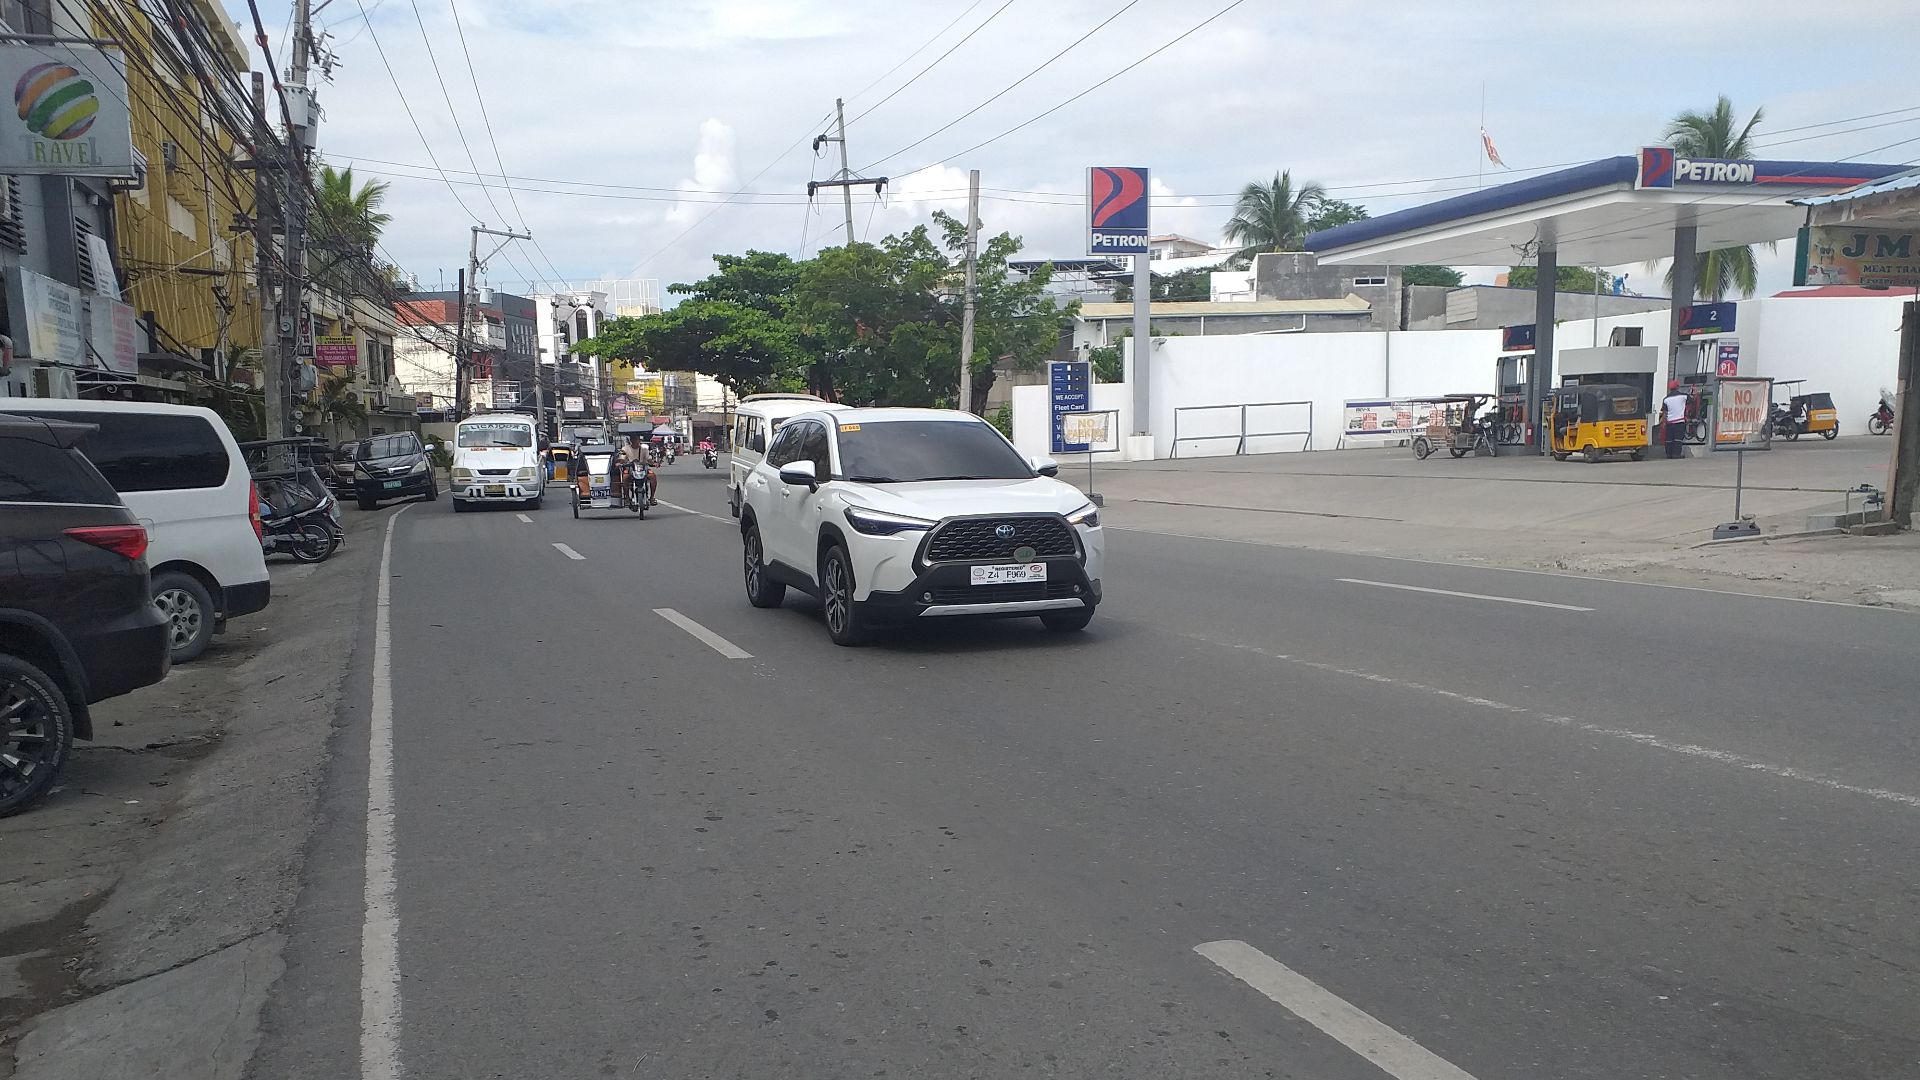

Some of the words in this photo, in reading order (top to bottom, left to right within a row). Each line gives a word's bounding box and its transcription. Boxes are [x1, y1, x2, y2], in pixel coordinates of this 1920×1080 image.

[19, 136, 103, 166] TRAVEL
[1675, 159, 1754, 182] PETRON
[1092, 233, 1148, 247] PETRON
[1863, 264, 1892, 273] MEAT
[1710, 310, 1717, 320] 2
[1525, 330, 1530, 340] 1
[1735, 389, 1752, 405] NO
[1078, 418, 1094, 427] NO
[1067, 427, 1105, 438] PARKING
